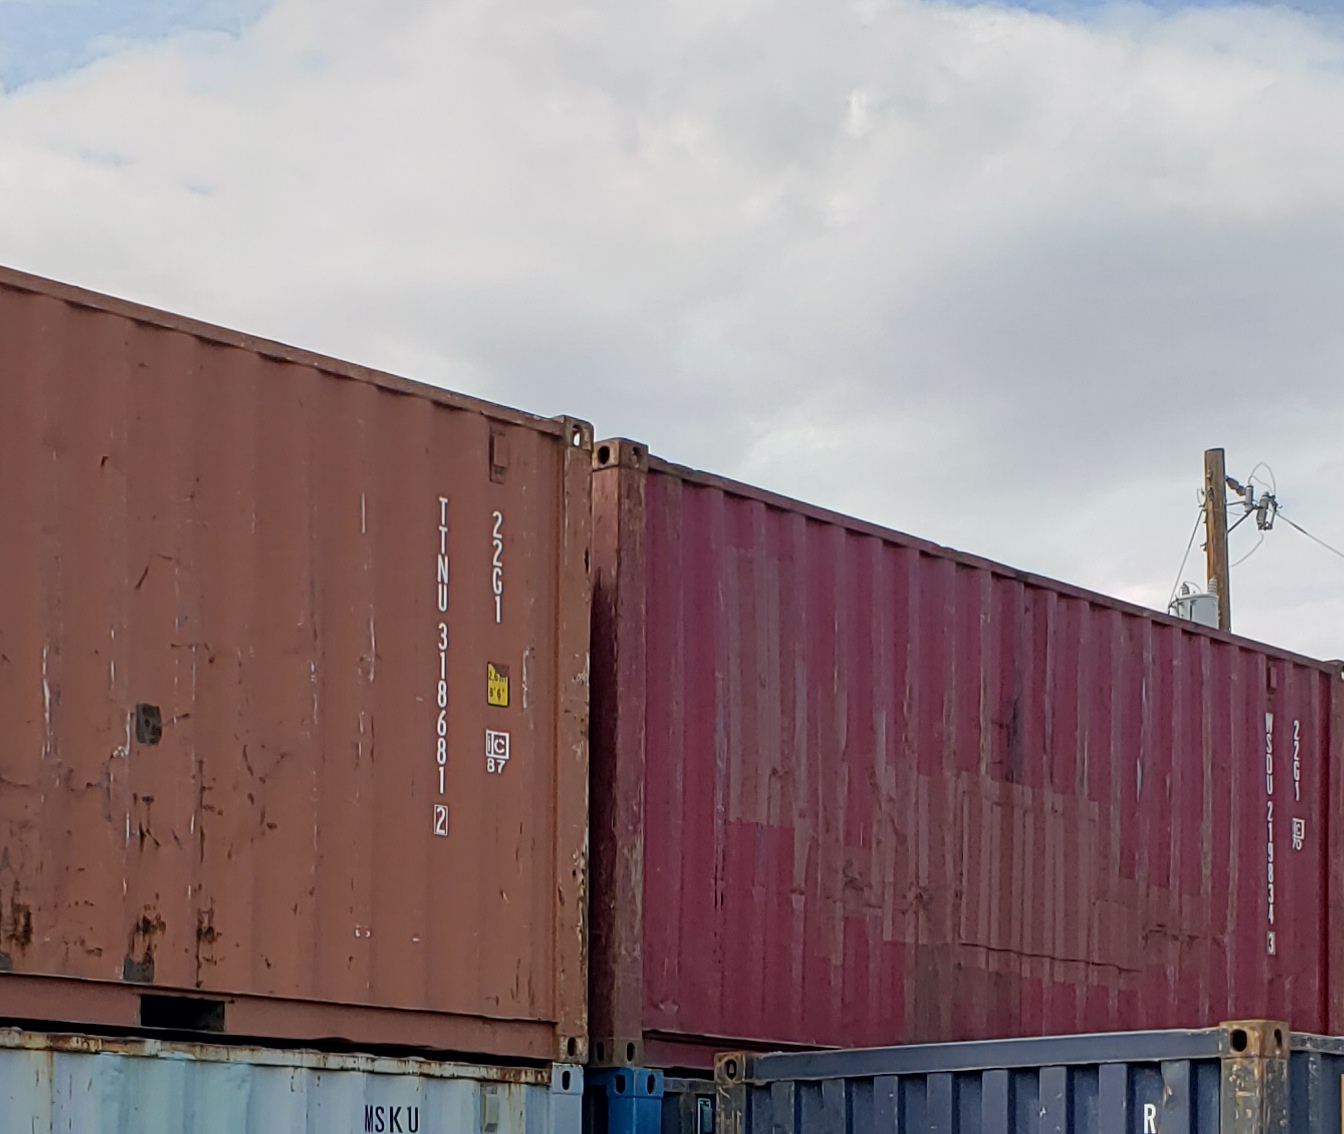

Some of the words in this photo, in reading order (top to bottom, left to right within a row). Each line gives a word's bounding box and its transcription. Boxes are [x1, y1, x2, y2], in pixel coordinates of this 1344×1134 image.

[437, 497, 449, 612] TTNU
[492, 511, 504, 623] 22G1
[437, 622, 448, 794] 318681
[487, 758, 506, 774] 87
[435, 806, 447, 835] 2
[365, 1105, 419, 1133] MSKU
